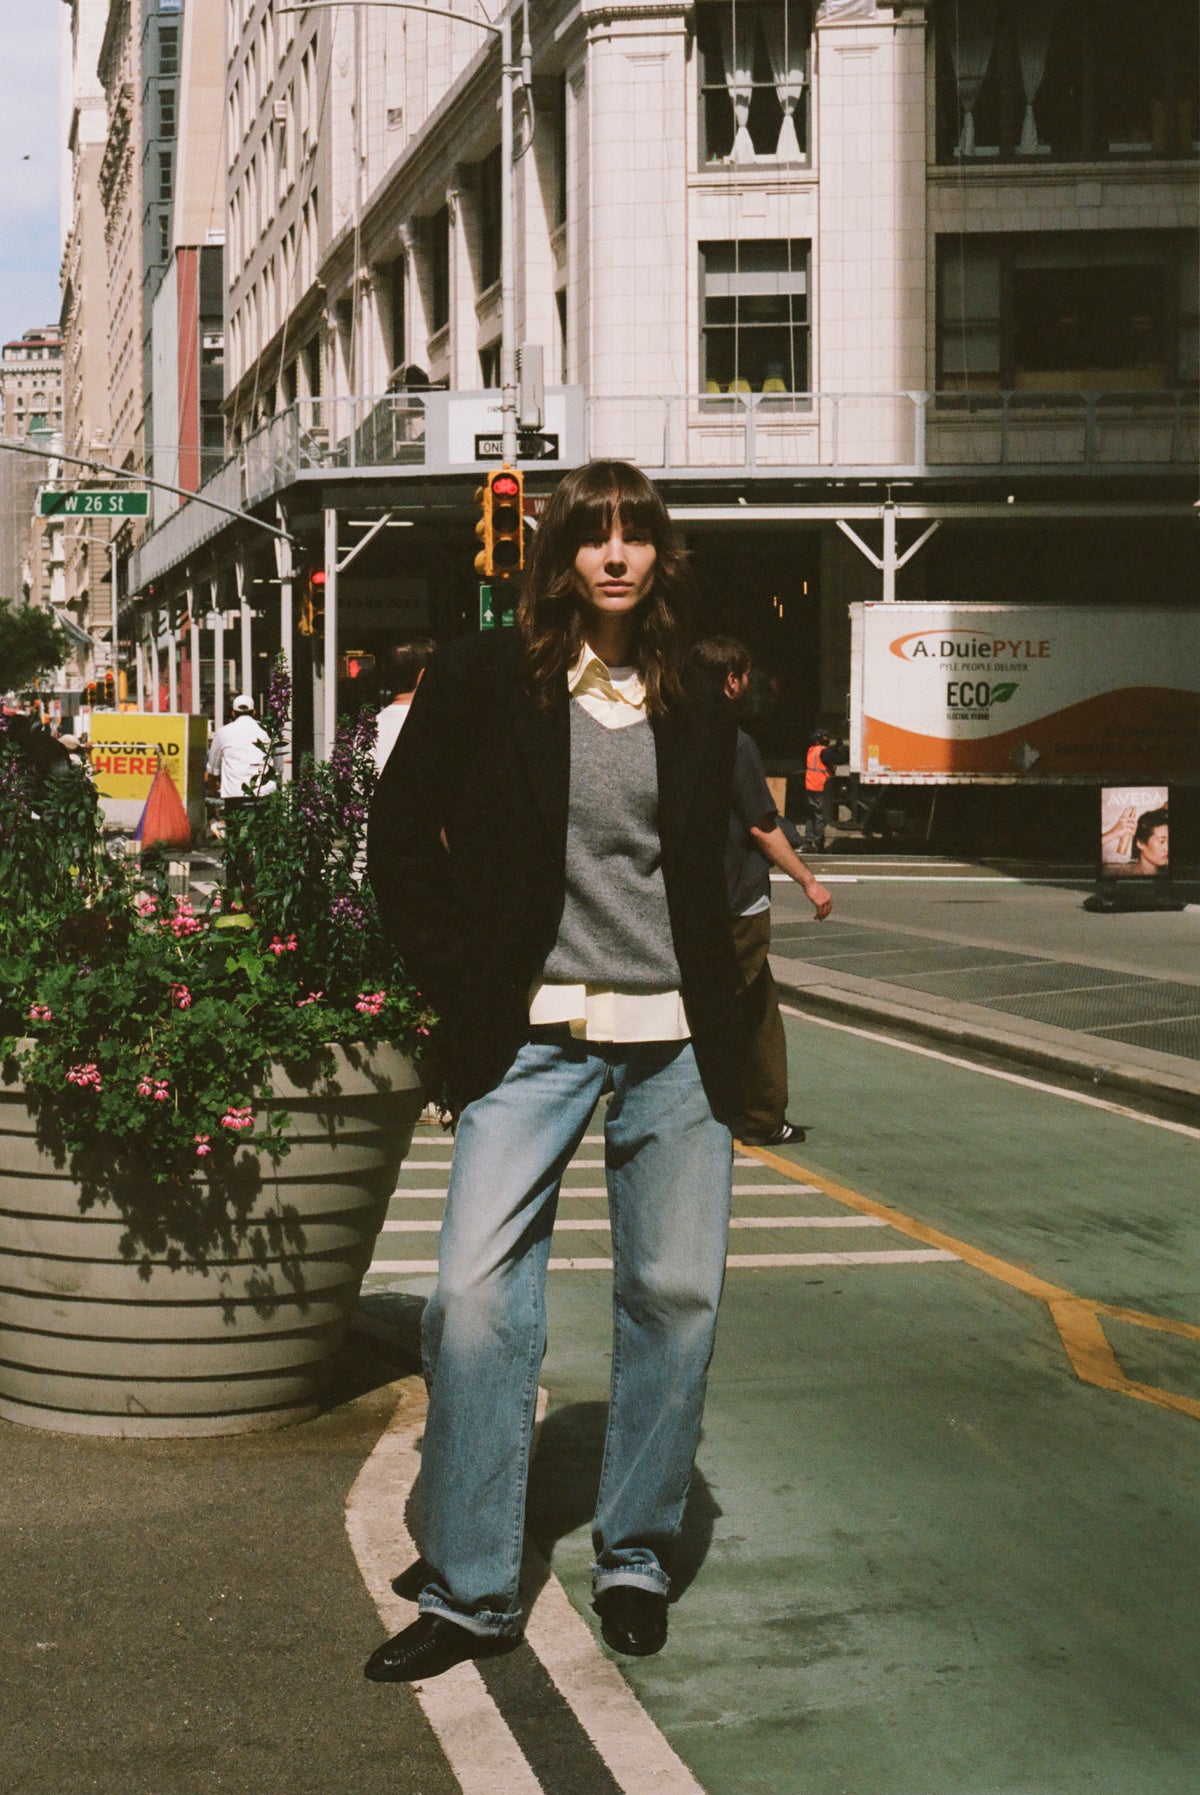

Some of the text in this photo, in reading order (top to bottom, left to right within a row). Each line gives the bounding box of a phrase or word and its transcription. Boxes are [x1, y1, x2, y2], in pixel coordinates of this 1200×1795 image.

[64, 495, 124, 512] W 26 St
[939, 663, 1028, 672] PYLE PEOPLE DELIVER
[947, 681, 990, 707] ECO
[97, 741, 180, 756] YOUR AD
[95, 756, 159, 776] HERE
[1107, 792, 1162, 807] AVEDA
